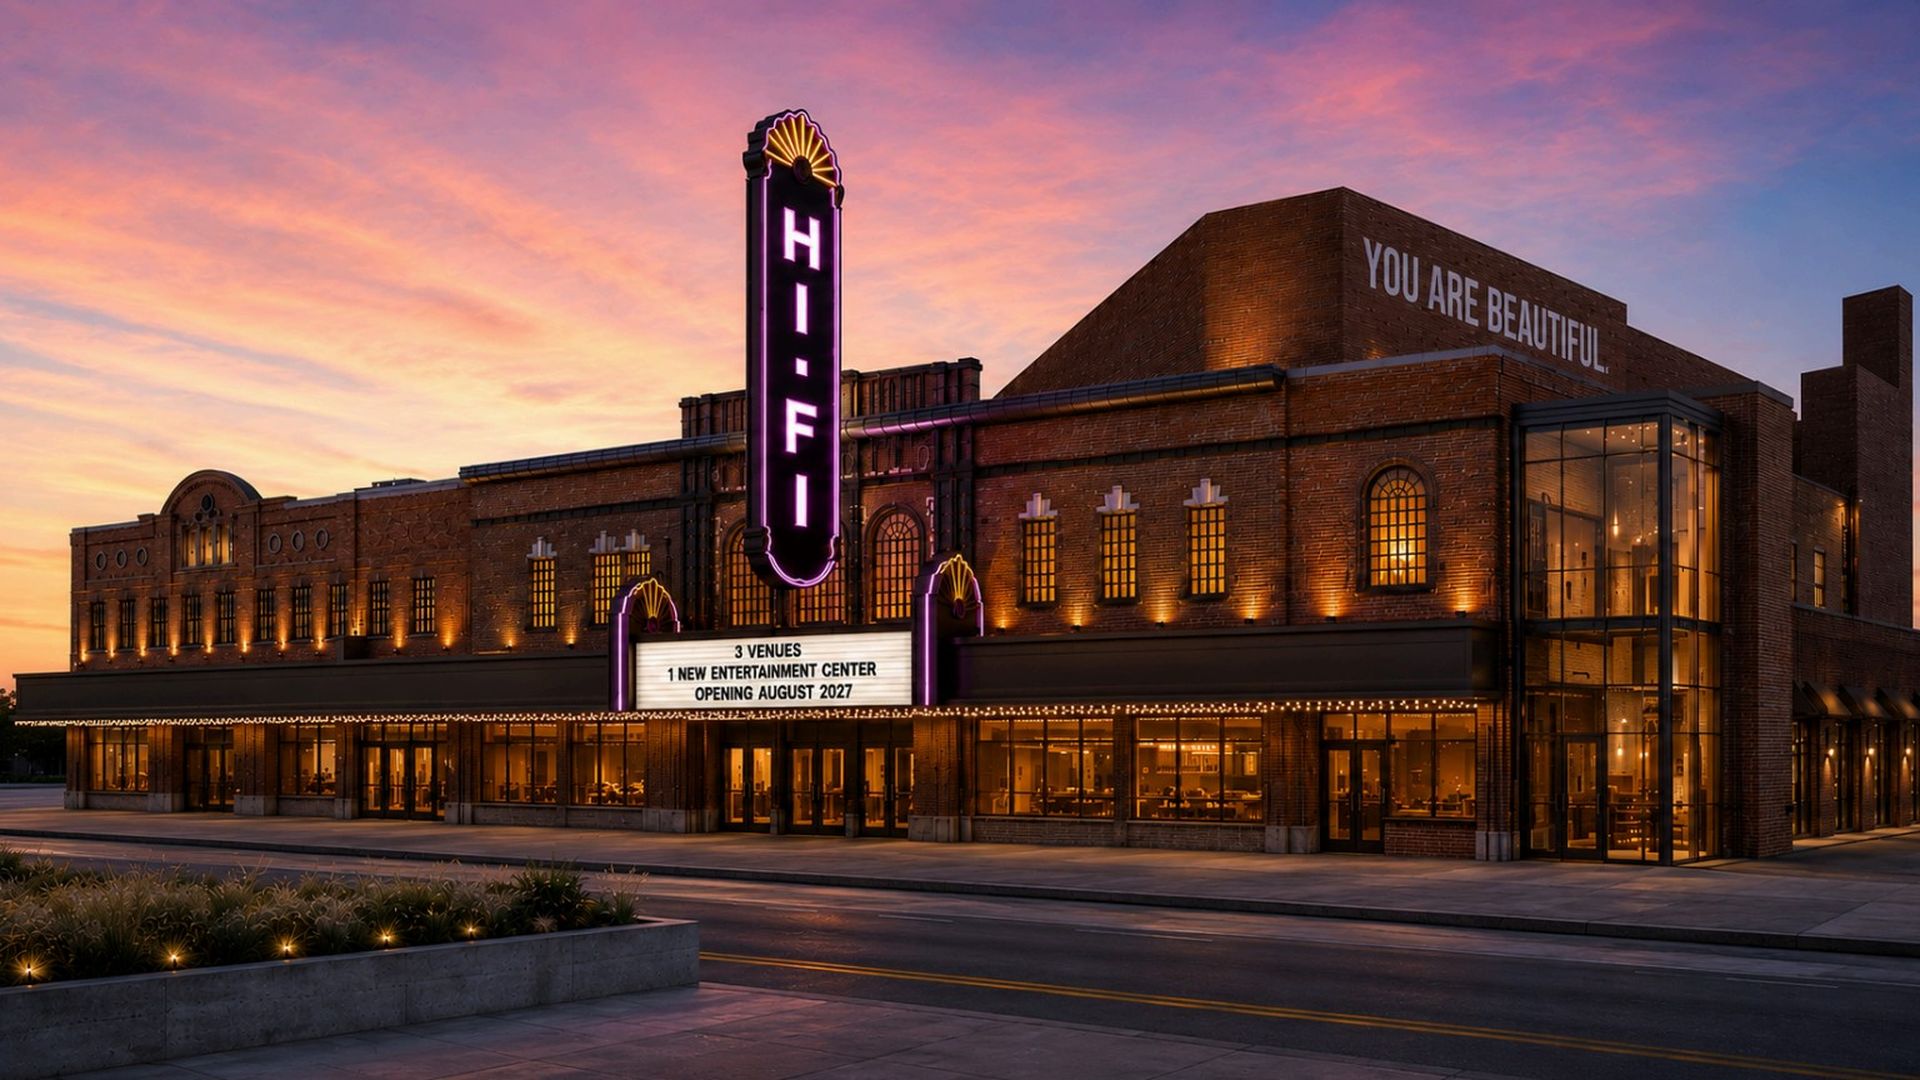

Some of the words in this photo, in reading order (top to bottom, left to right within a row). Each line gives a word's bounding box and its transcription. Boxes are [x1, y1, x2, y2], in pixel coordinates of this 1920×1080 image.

[1363, 236, 1419, 304] YOU
[1427, 264, 1479, 327] ARE
[1487, 285, 1609, 374] BEAUTIFUL.
[735, 645, 743, 659] 3
[747, 643, 802, 658] VENUES
[668, 667, 674, 682] 1
[678, 665, 707, 681] NEW
[711, 663, 818, 680] ENTERTAINMENT
[822, 661, 877, 677] CENTER
[695, 685, 753, 701] OPENING
[758, 684, 814, 700] AUGUST
[819, 683, 853, 699] 2027
